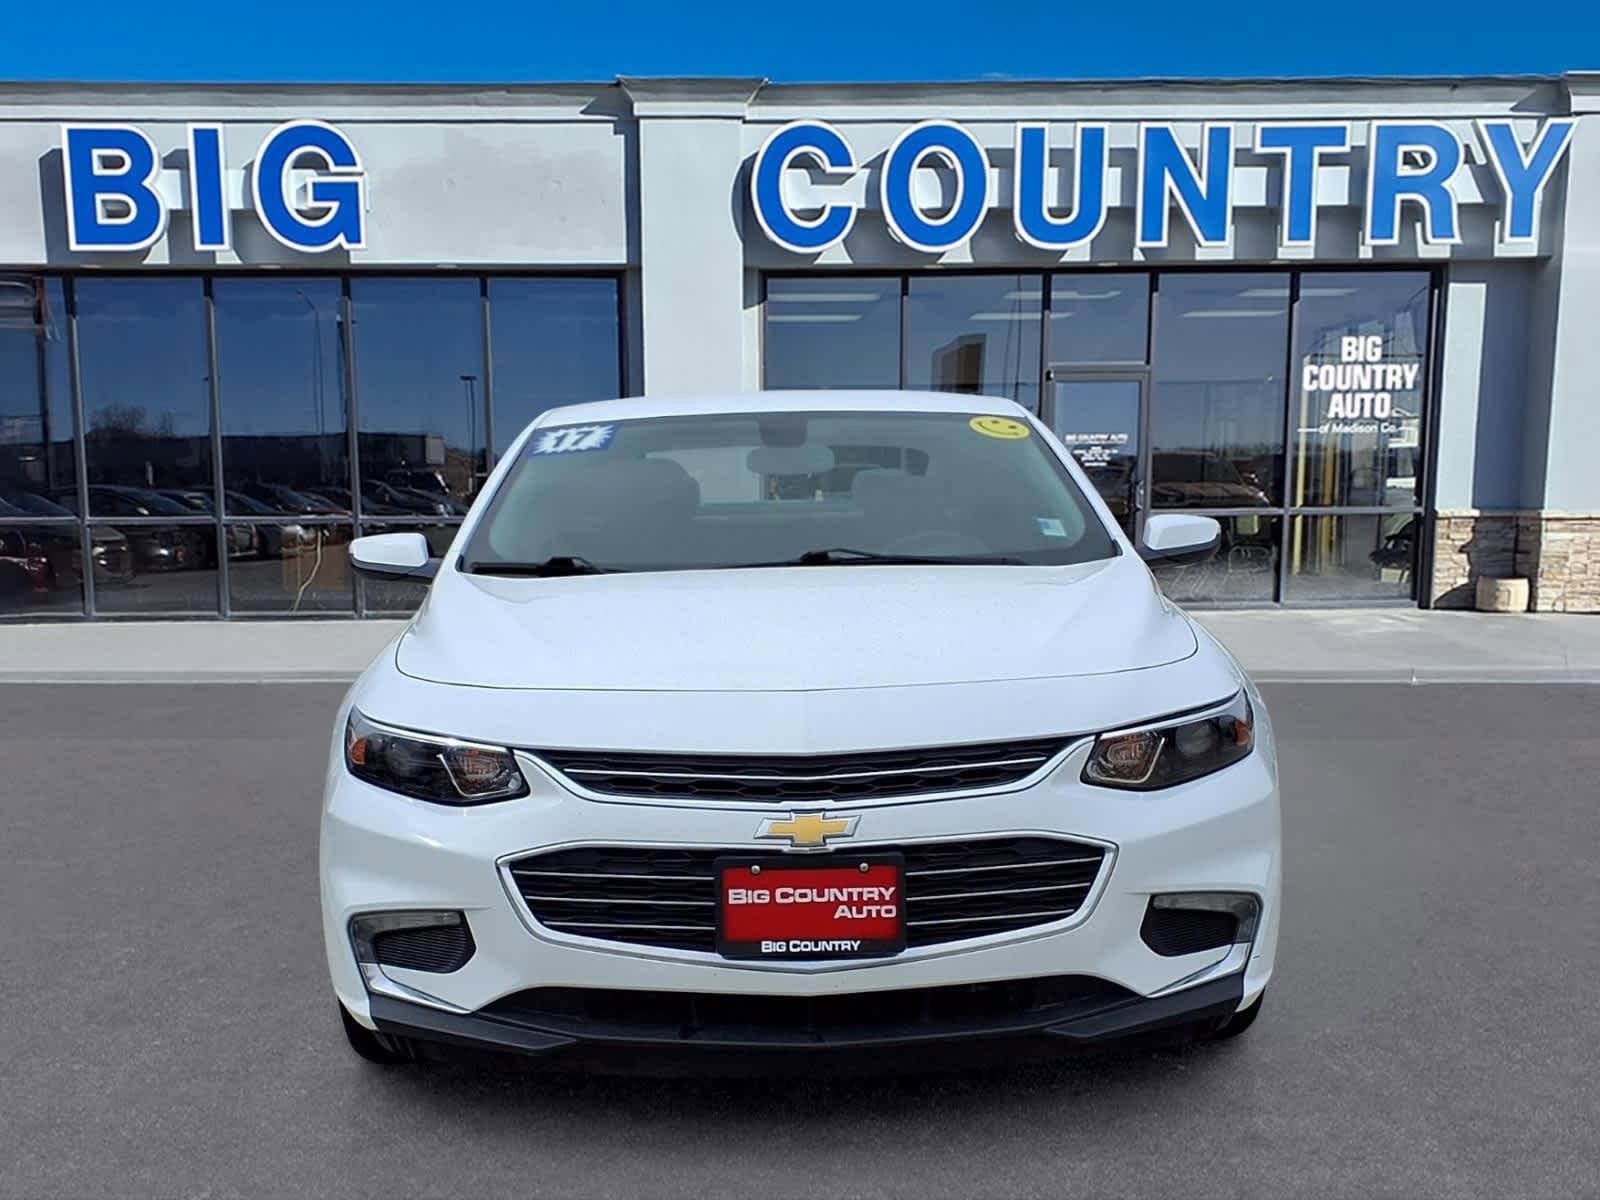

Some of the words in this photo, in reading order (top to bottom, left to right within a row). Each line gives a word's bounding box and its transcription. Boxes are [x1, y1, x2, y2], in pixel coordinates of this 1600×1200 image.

[61, 120, 368, 253] BIG
[750, 117, 1574, 253] COUNTRY
[1341, 336, 1382, 362] BIG
[1303, 364, 1419, 390] COUNTRY
[1328, 393, 1392, 418] AUTO
[1332, 423, 1378, 433] Madison
[728, 889, 770, 905] BIG
[775, 887, 896, 904] COUNTRY
[833, 905, 897, 919] AUTO
[761, 941, 786, 953] BIG
[789, 940, 861, 952] COUNTRY
